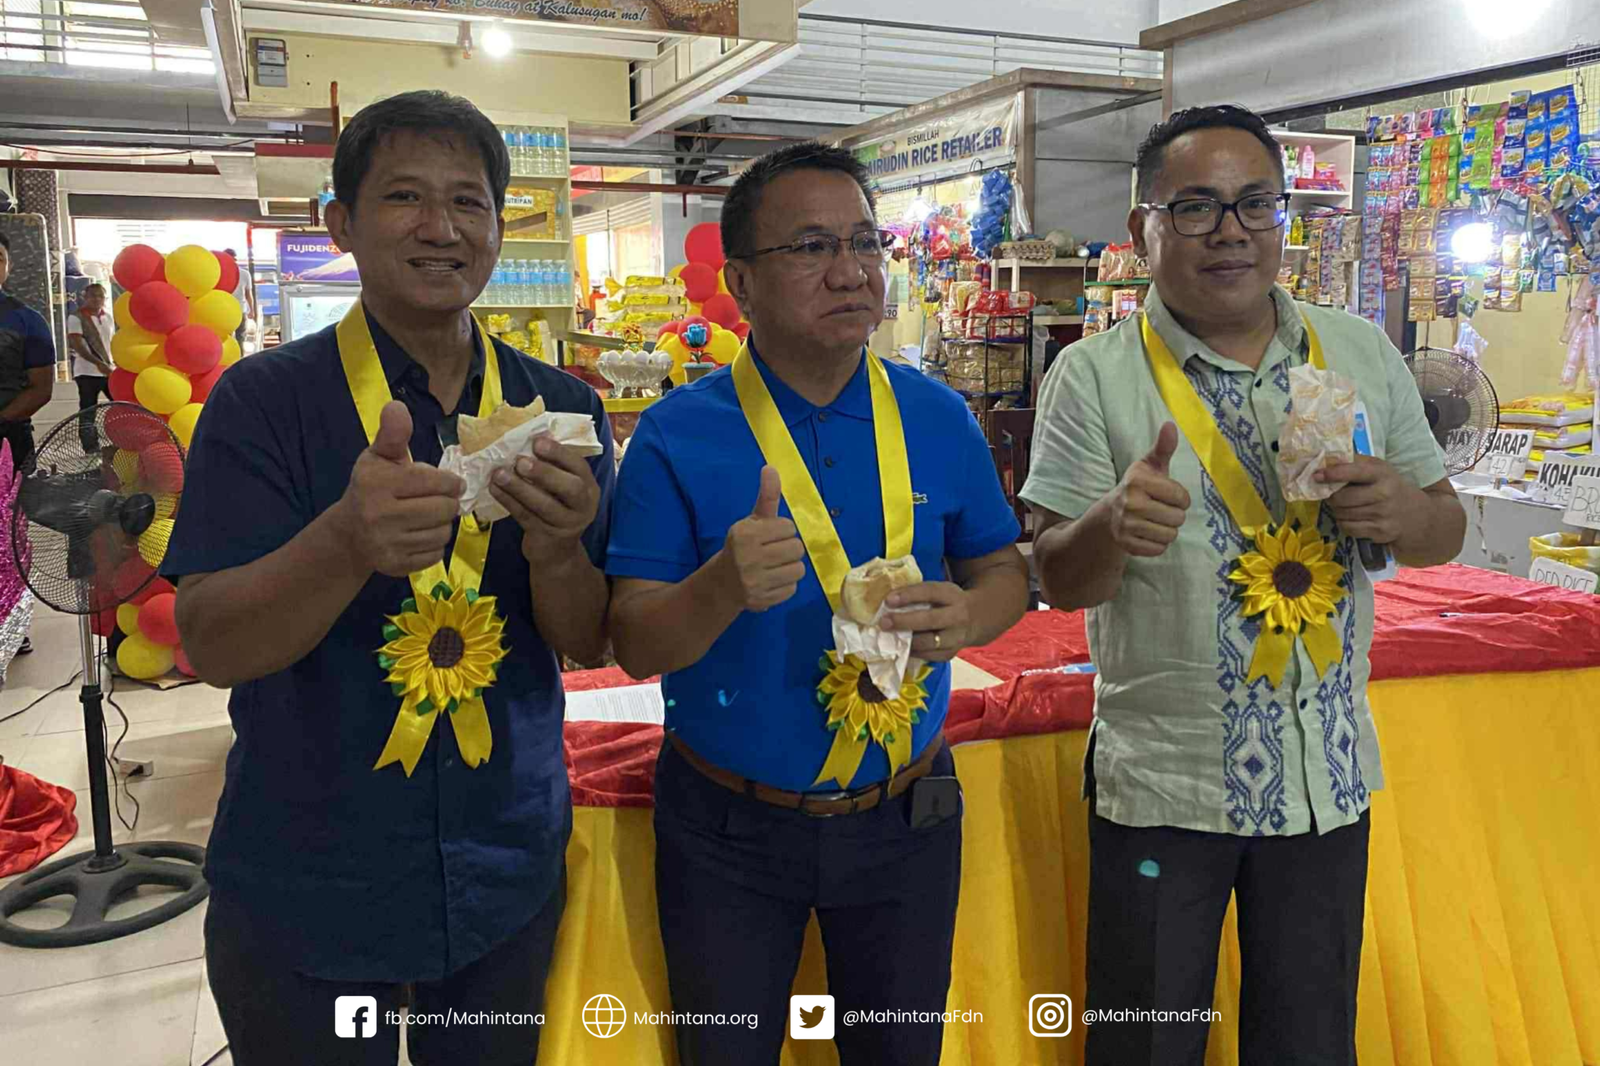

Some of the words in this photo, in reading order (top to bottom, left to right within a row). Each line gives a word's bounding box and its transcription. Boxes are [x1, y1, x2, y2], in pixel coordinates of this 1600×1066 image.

[524, 2, 541, 13] at
[543, 0, 617, 21] Kalusugan
[621, 8, 648, 21] mo!
[907, 129, 940, 146] BISMILLAH
[868, 151, 909, 176] AIRUDIN
[911, 143, 939, 168] RICE
[941, 126, 1003, 160] RETAILER
[504, 196, 533, 205] UTRIPAN
